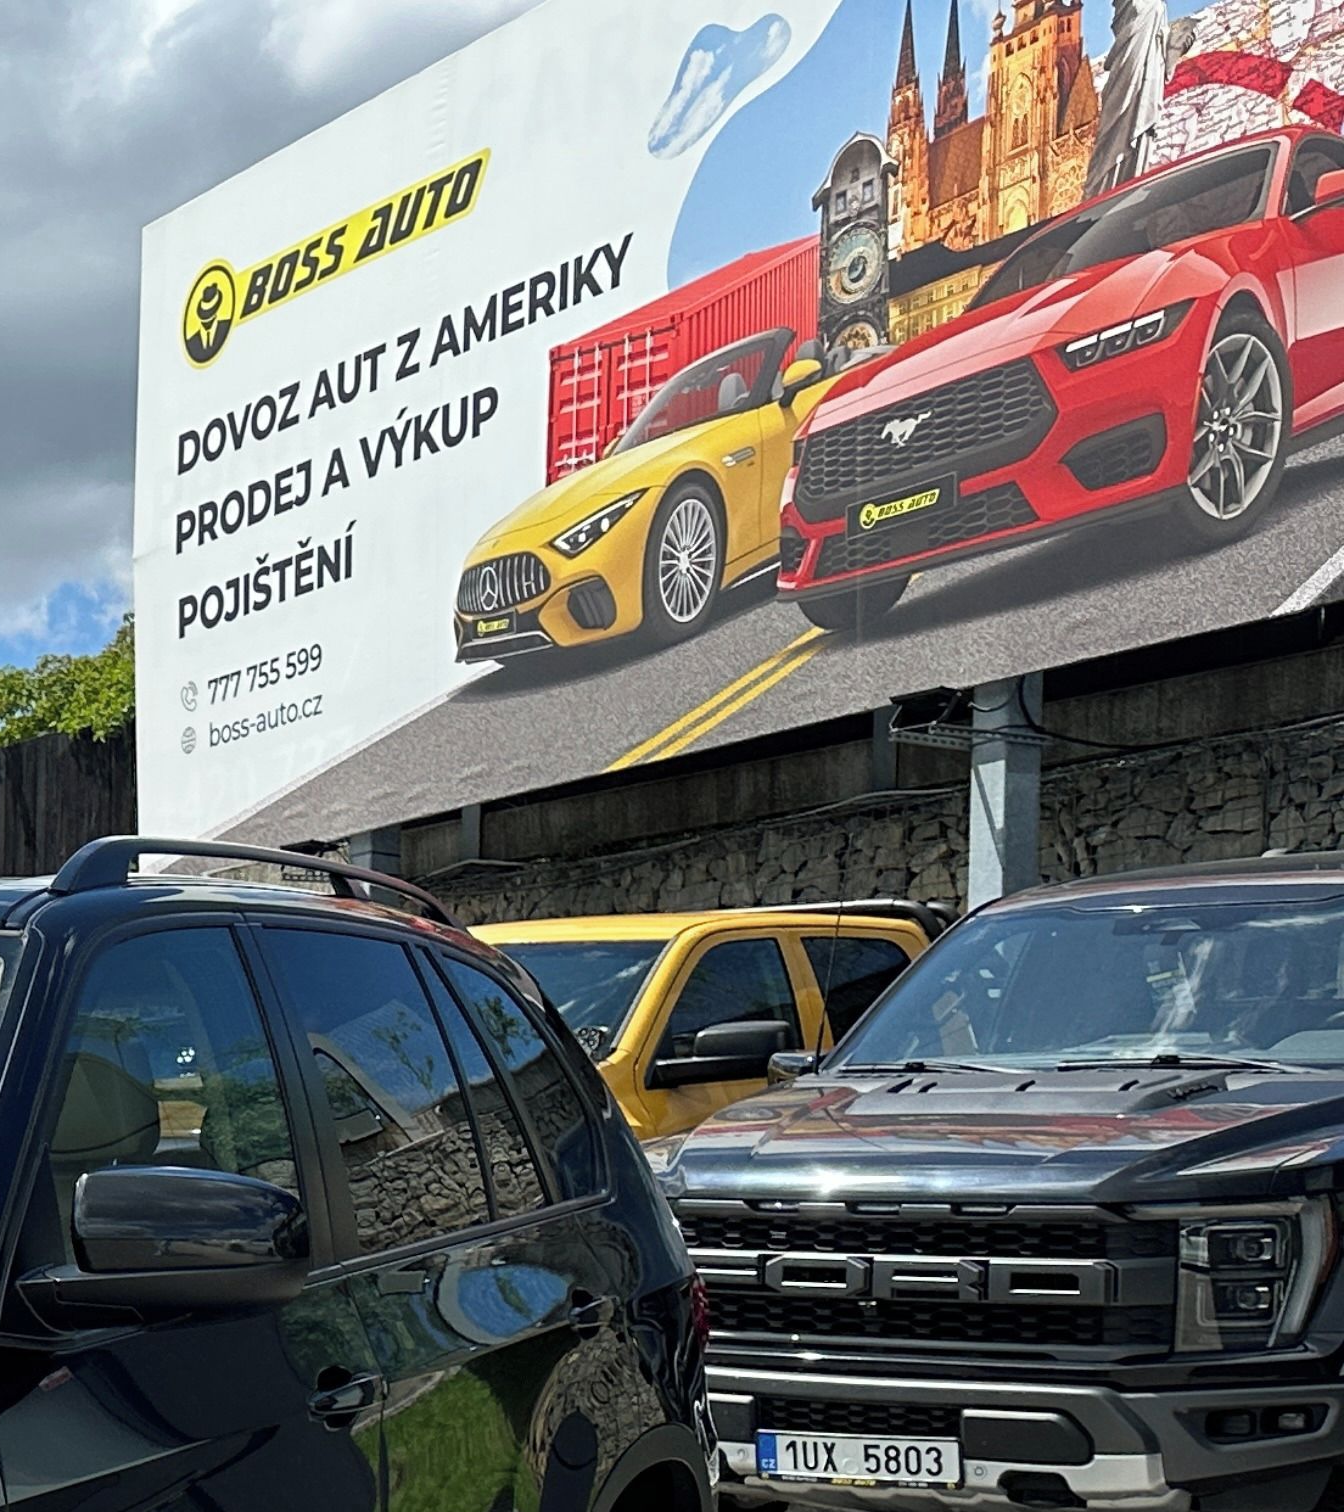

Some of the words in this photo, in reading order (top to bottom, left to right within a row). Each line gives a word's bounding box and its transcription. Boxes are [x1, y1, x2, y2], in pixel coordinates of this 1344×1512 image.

[239, 223, 349, 320] BOSS
[353, 158, 483, 264] AUTO
[177, 380, 301, 476] DOVOZ
[307, 342, 387, 420] AUT
[395, 327, 422, 382] Z
[429, 232, 635, 368] AMERIKY
[176, 458, 313, 555] PRODEJ
[321, 447, 351, 497] A
[359, 386, 499, 479] VÝKUP
[877, 501, 904, 518] BOSS
[178, 519, 357, 639] POJIŠTĚNÍ
[208, 670, 242, 705] 777
[246, 657, 281, 693] 755
[285, 643, 323, 679] 599
[209, 694, 323, 747] boss-auto.cz
[762, 1458, 776, 1469] CZ
[785, 1440, 838, 1473] 1UX
[863, 1444, 943, 1477] 5803
